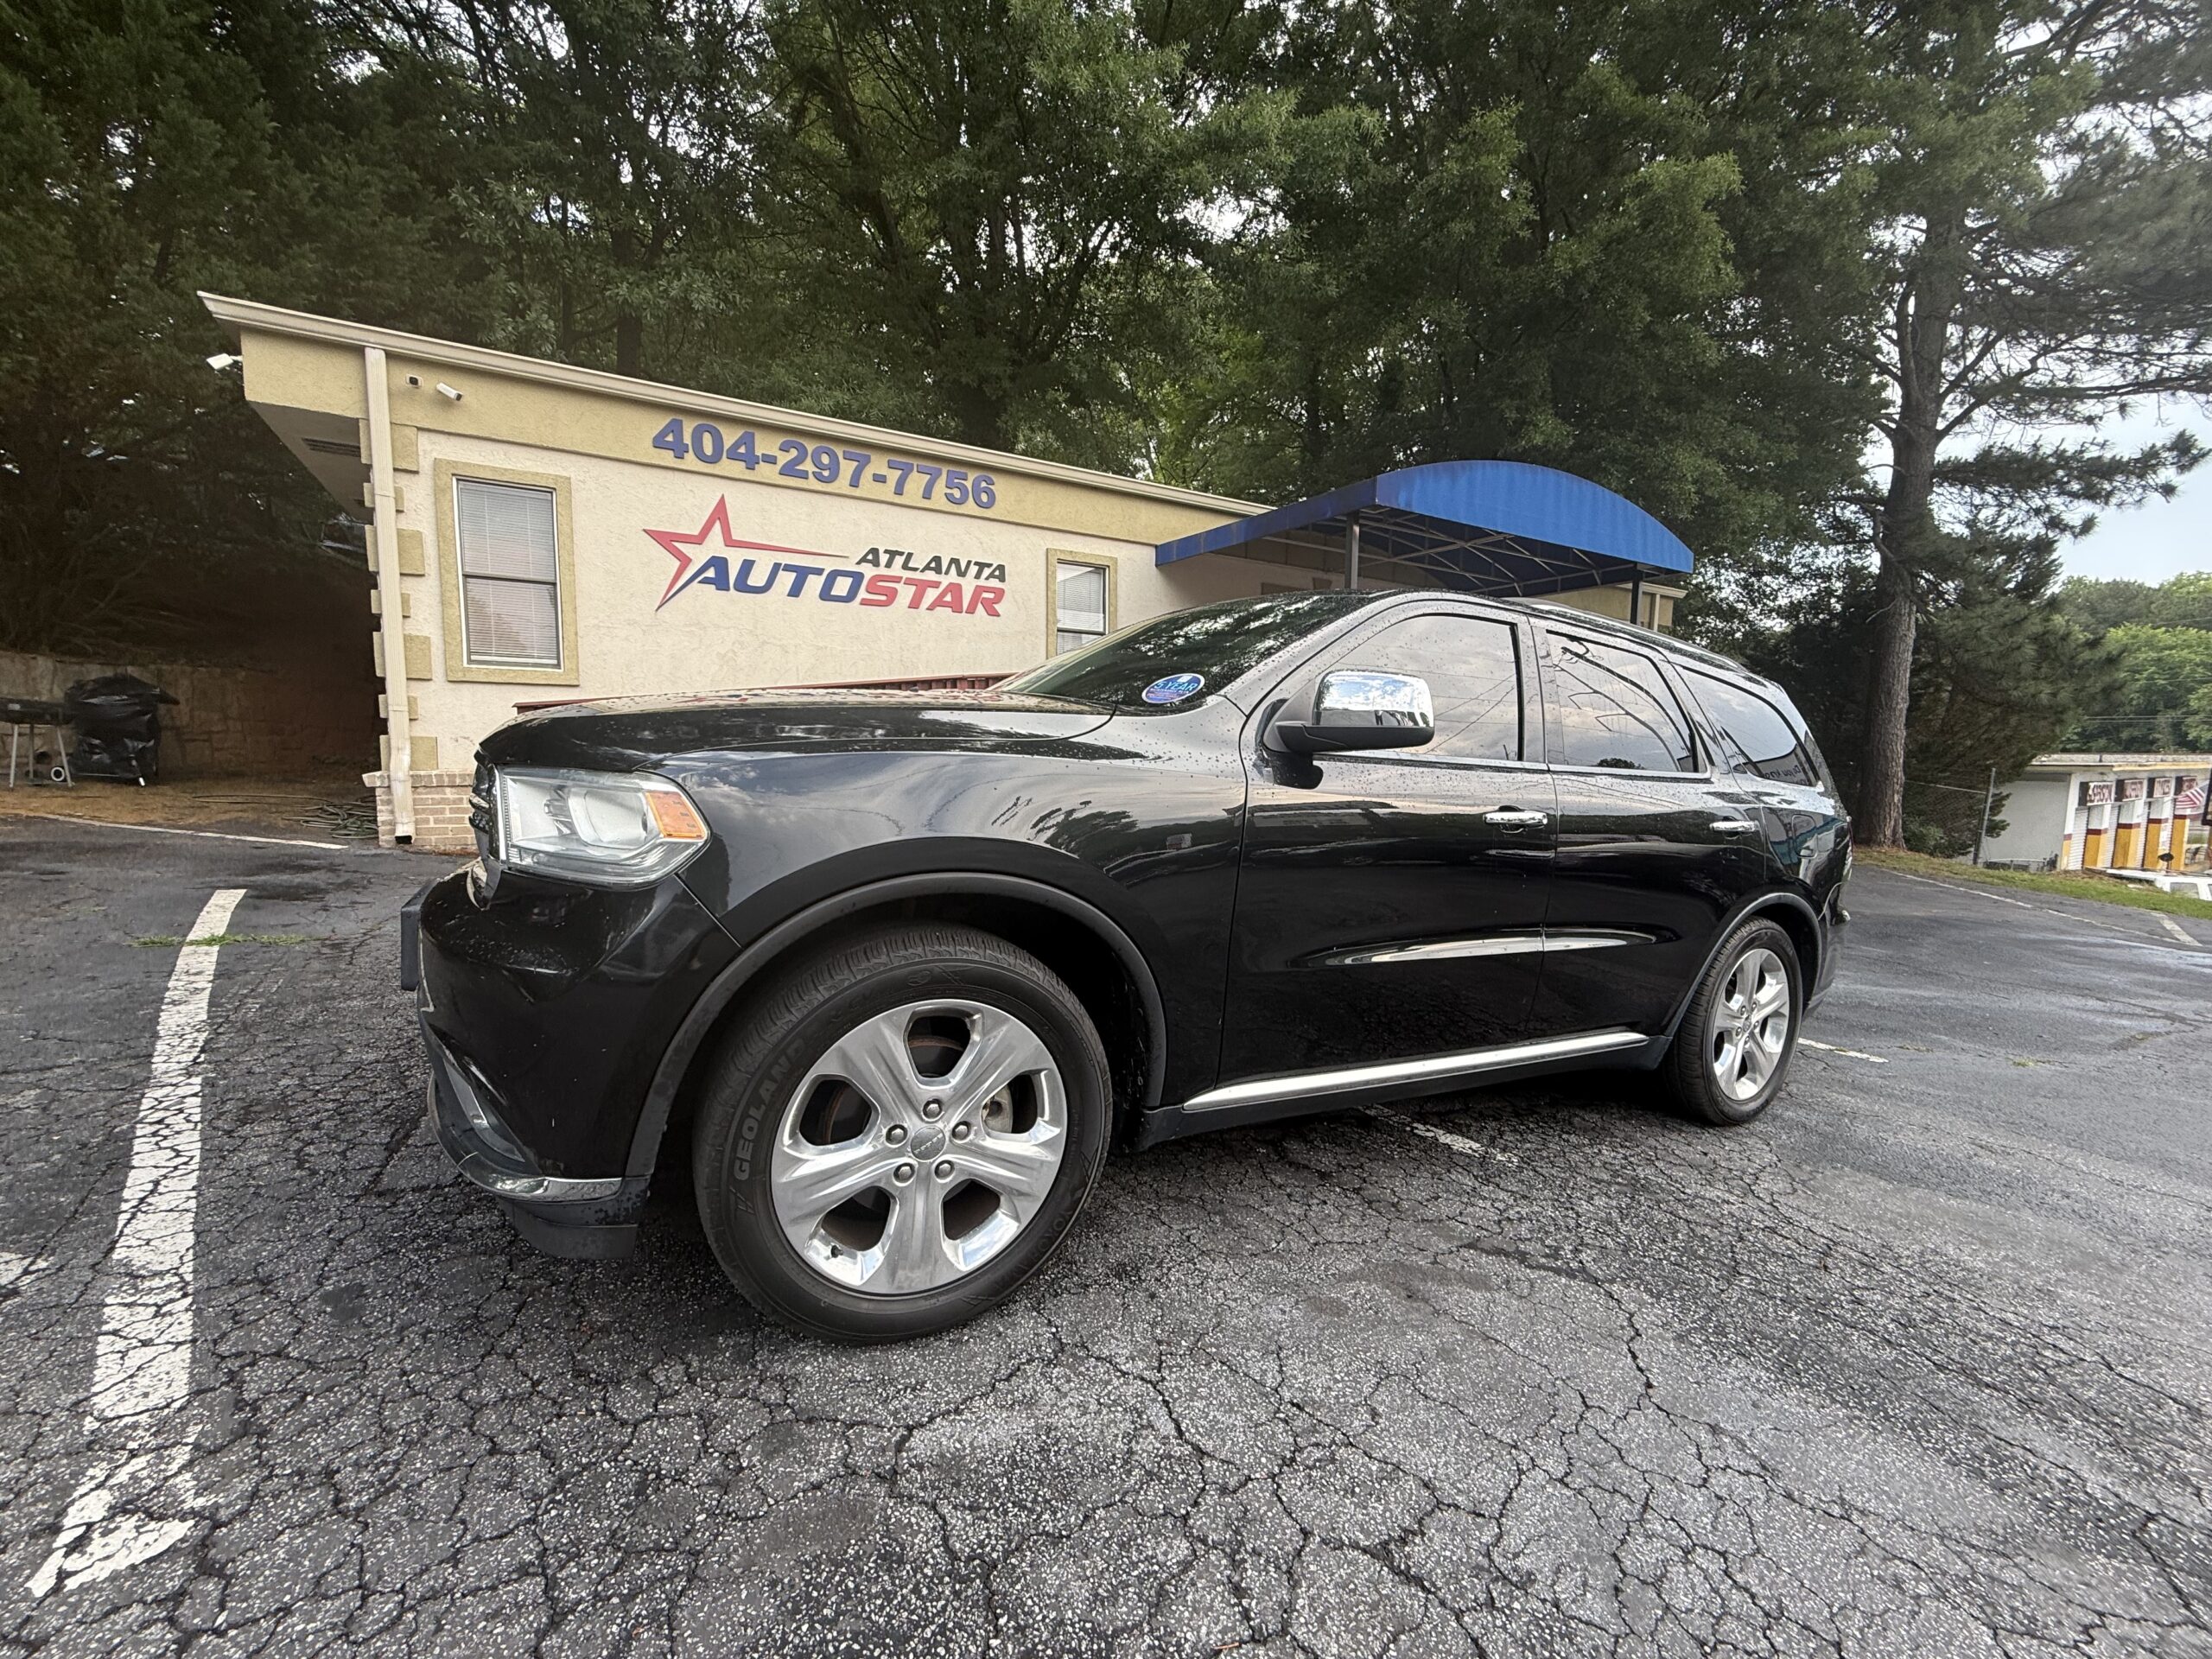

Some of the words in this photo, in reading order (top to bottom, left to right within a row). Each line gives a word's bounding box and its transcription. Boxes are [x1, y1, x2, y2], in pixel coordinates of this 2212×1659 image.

[652, 418, 997, 509] 404-297-7756
[855, 547, 1007, 583] ATLANTA
[1166, 681, 1198, 691] YEAR
